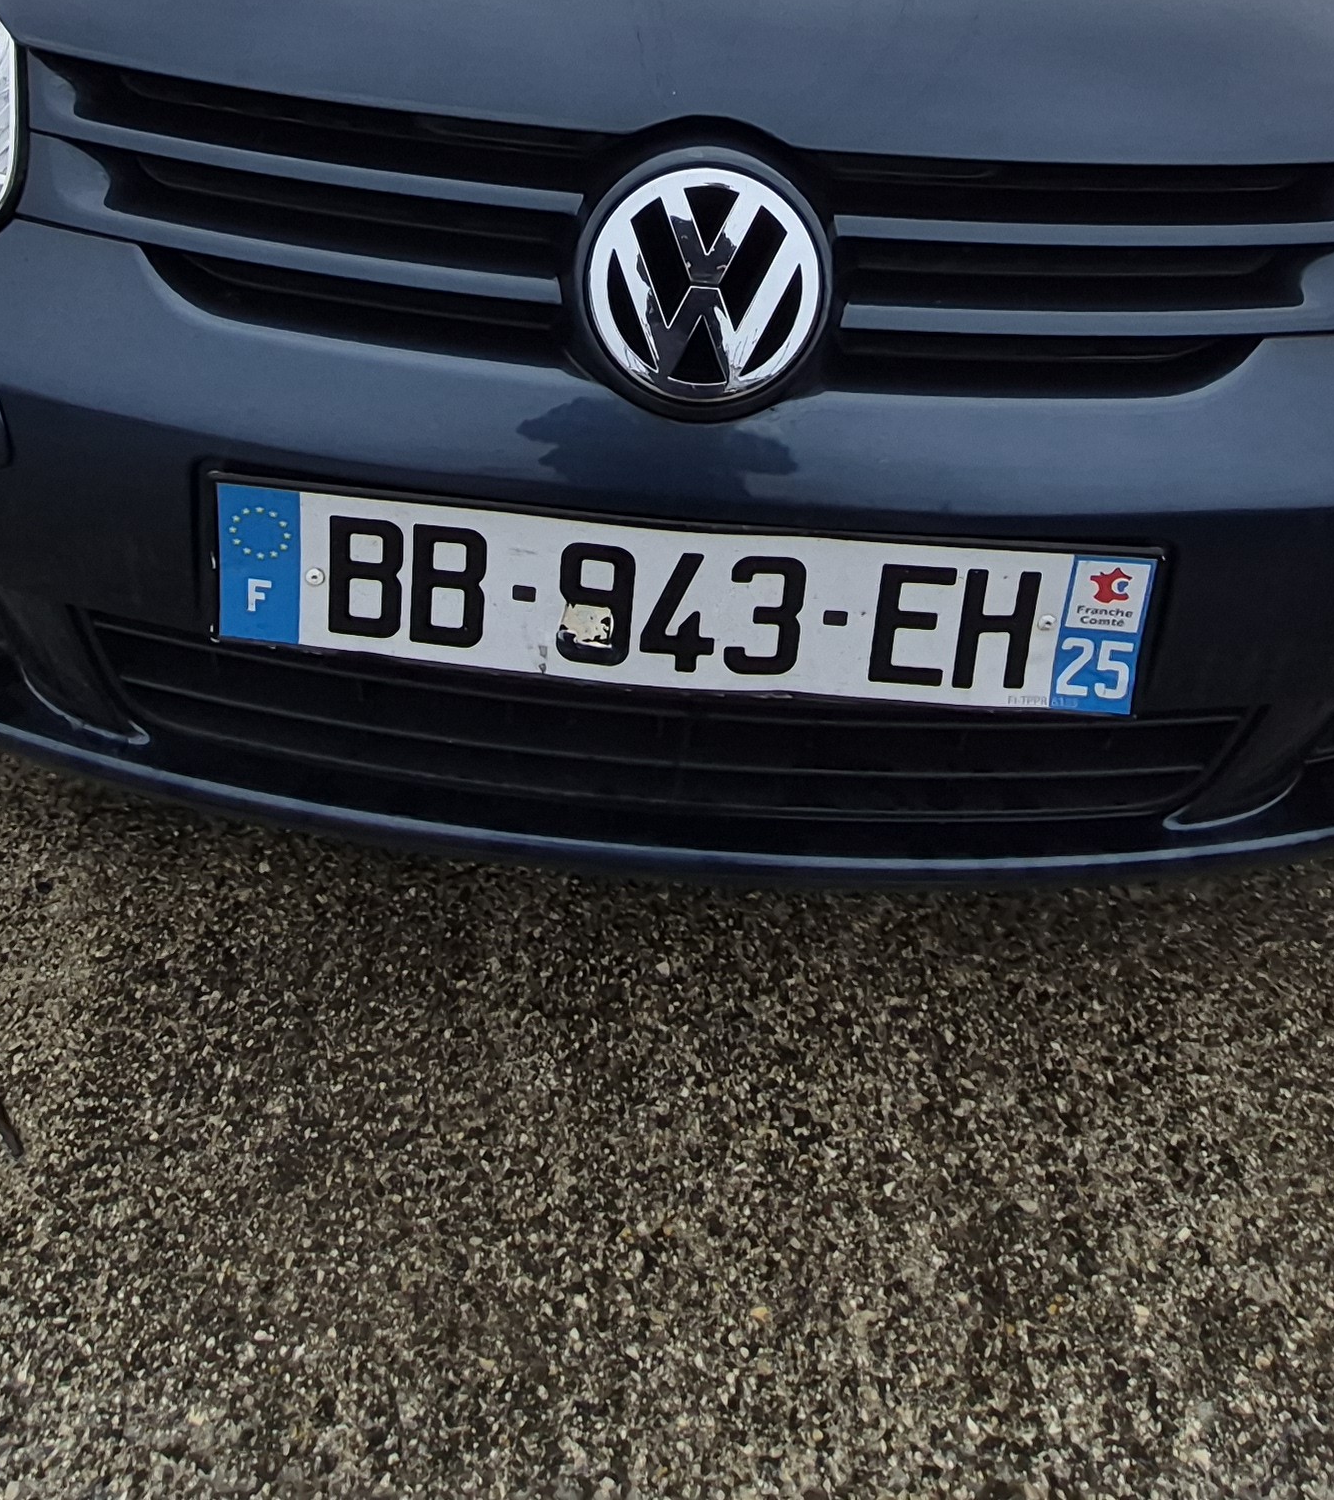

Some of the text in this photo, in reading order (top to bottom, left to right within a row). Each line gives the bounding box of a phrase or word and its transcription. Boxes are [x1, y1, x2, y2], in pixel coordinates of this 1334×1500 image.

[246, 578, 273, 612] F
[327, 514, 1043, 690] BB-943-EH
[1076, 604, 1134, 619] Franche
[1080, 615, 1126, 627] Comté
[1055, 636, 1135, 700] 25
